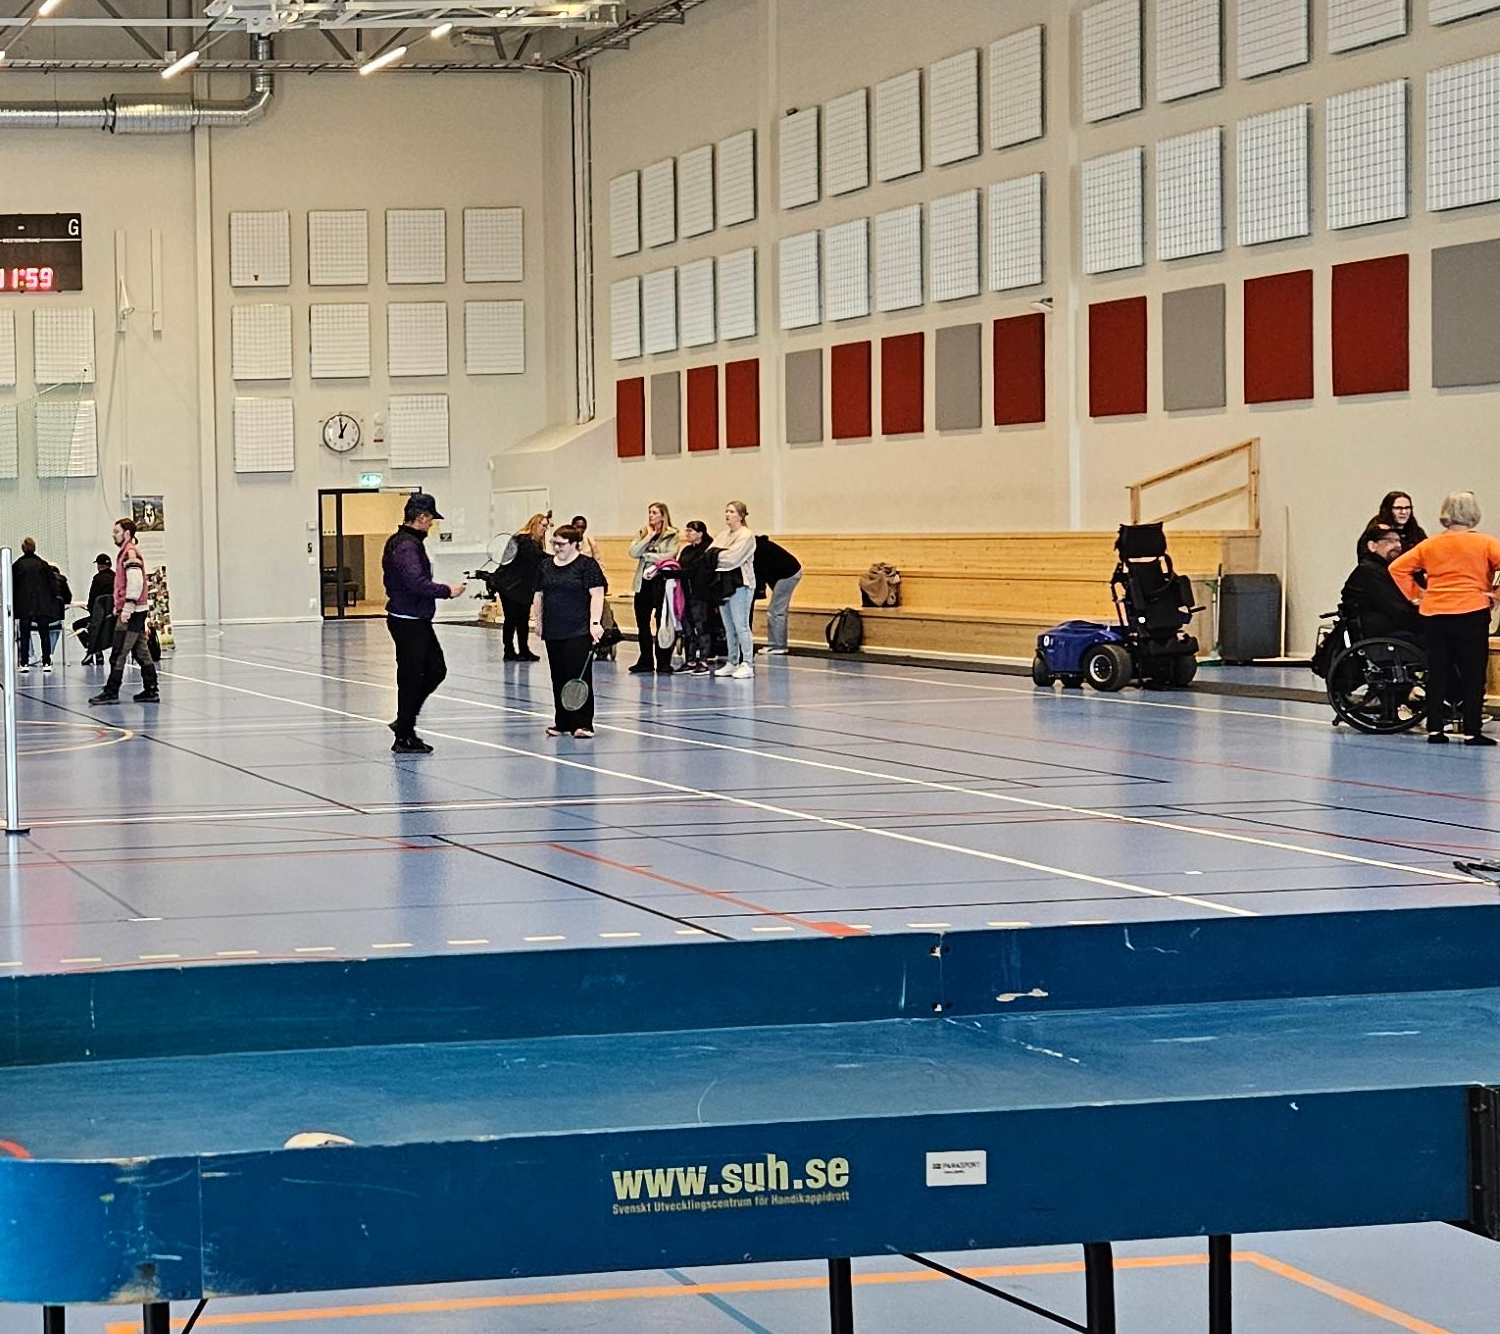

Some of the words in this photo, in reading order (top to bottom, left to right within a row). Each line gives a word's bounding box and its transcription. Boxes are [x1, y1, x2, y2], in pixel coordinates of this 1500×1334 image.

[68, 218, 80, 236] G
[611, 1153, 850, 1200] www.suh.se
[611, 1201, 652, 1215] Svenskt
[653, 1198, 752, 1212] Utvecklingscentrum
[754, 1195, 769, 1206] för
[771, 1191, 850, 1205] Handikappidrott
